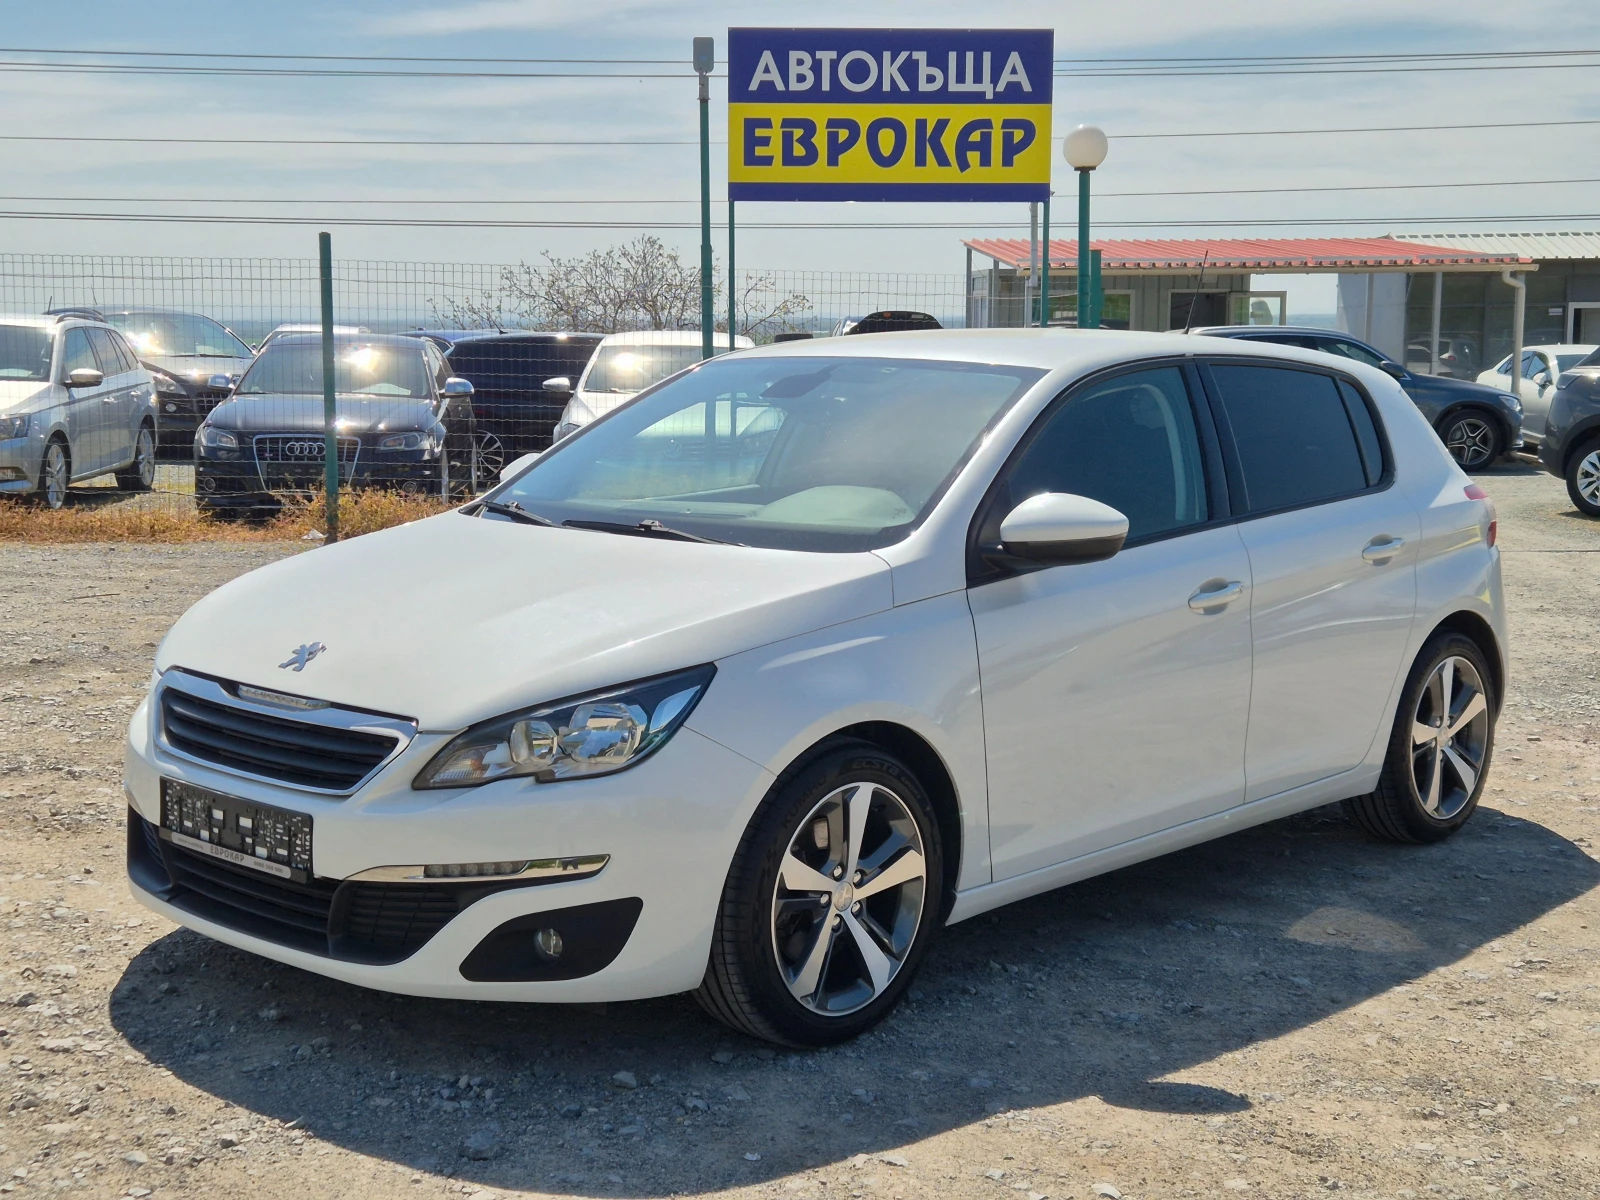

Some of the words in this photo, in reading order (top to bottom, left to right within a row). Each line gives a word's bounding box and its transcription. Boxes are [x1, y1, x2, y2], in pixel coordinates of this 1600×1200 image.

[748, 50, 1032, 99] АВТОКЪЩА
[743, 117, 1036, 173] ЕВРОКАР
[210, 845, 245, 863] ЕВРОКАР
